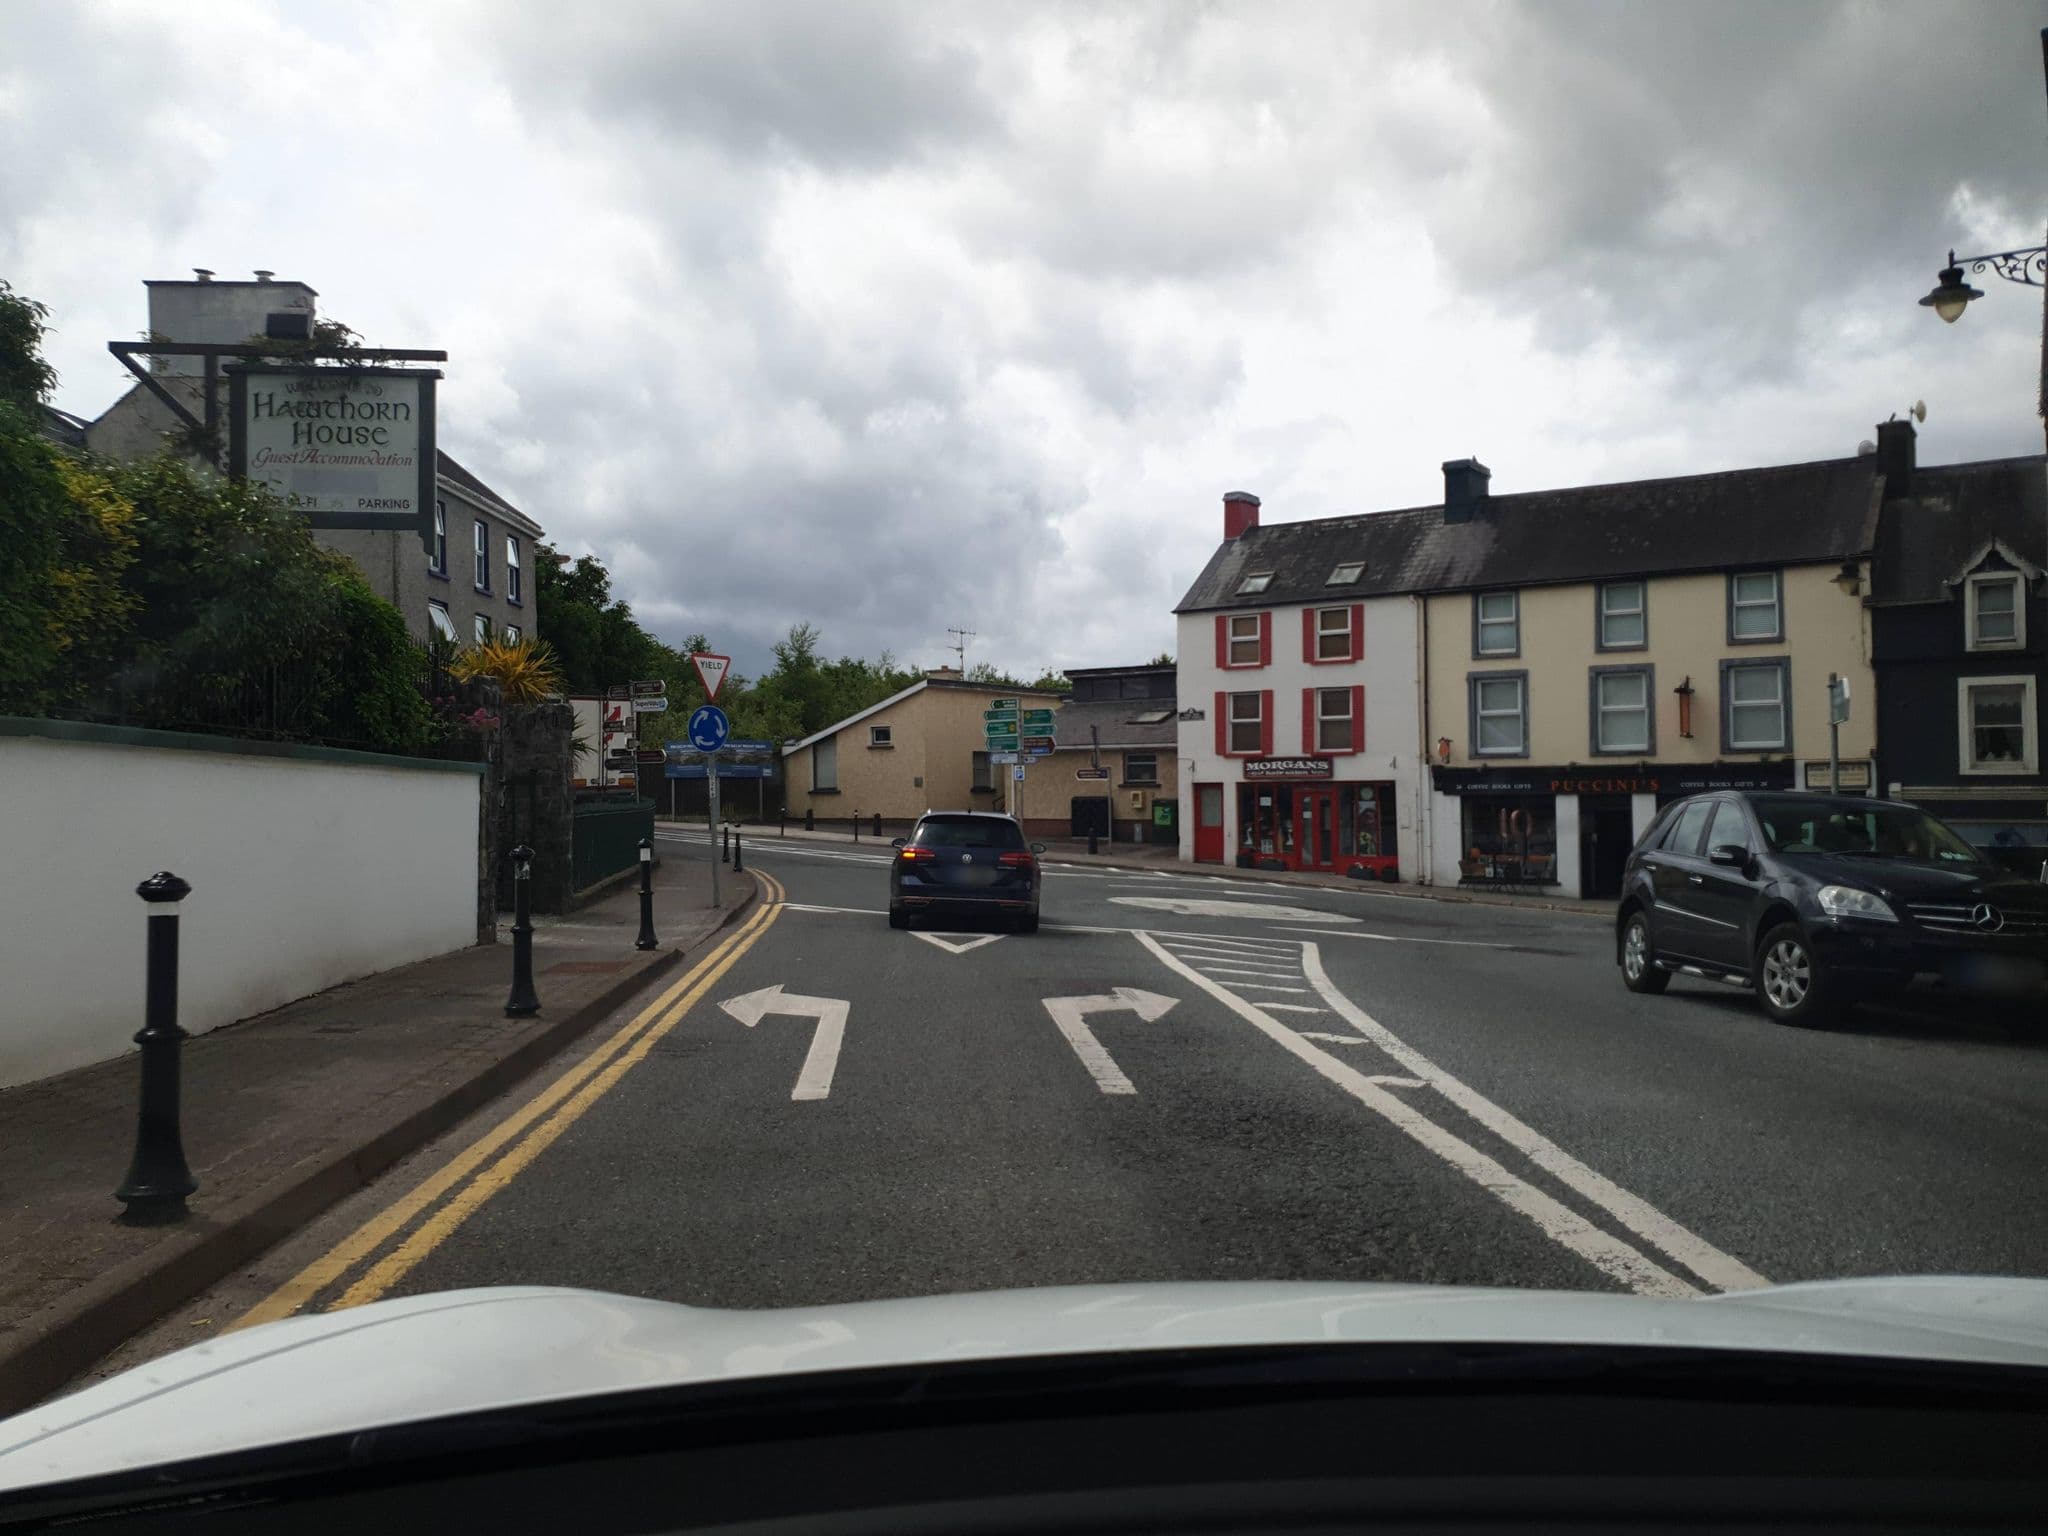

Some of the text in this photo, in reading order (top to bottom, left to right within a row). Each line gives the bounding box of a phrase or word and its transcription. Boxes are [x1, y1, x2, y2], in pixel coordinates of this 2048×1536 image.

[293, 421, 389, 445] House
[252, 448, 413, 468] Guest Accommodation
[358, 498, 410, 509] PARKING
[700, 660, 723, 669] YIELD
[1246, 761, 1329, 770] MORGANS
[1551, 780, 1660, 792] PUCCINI'S
